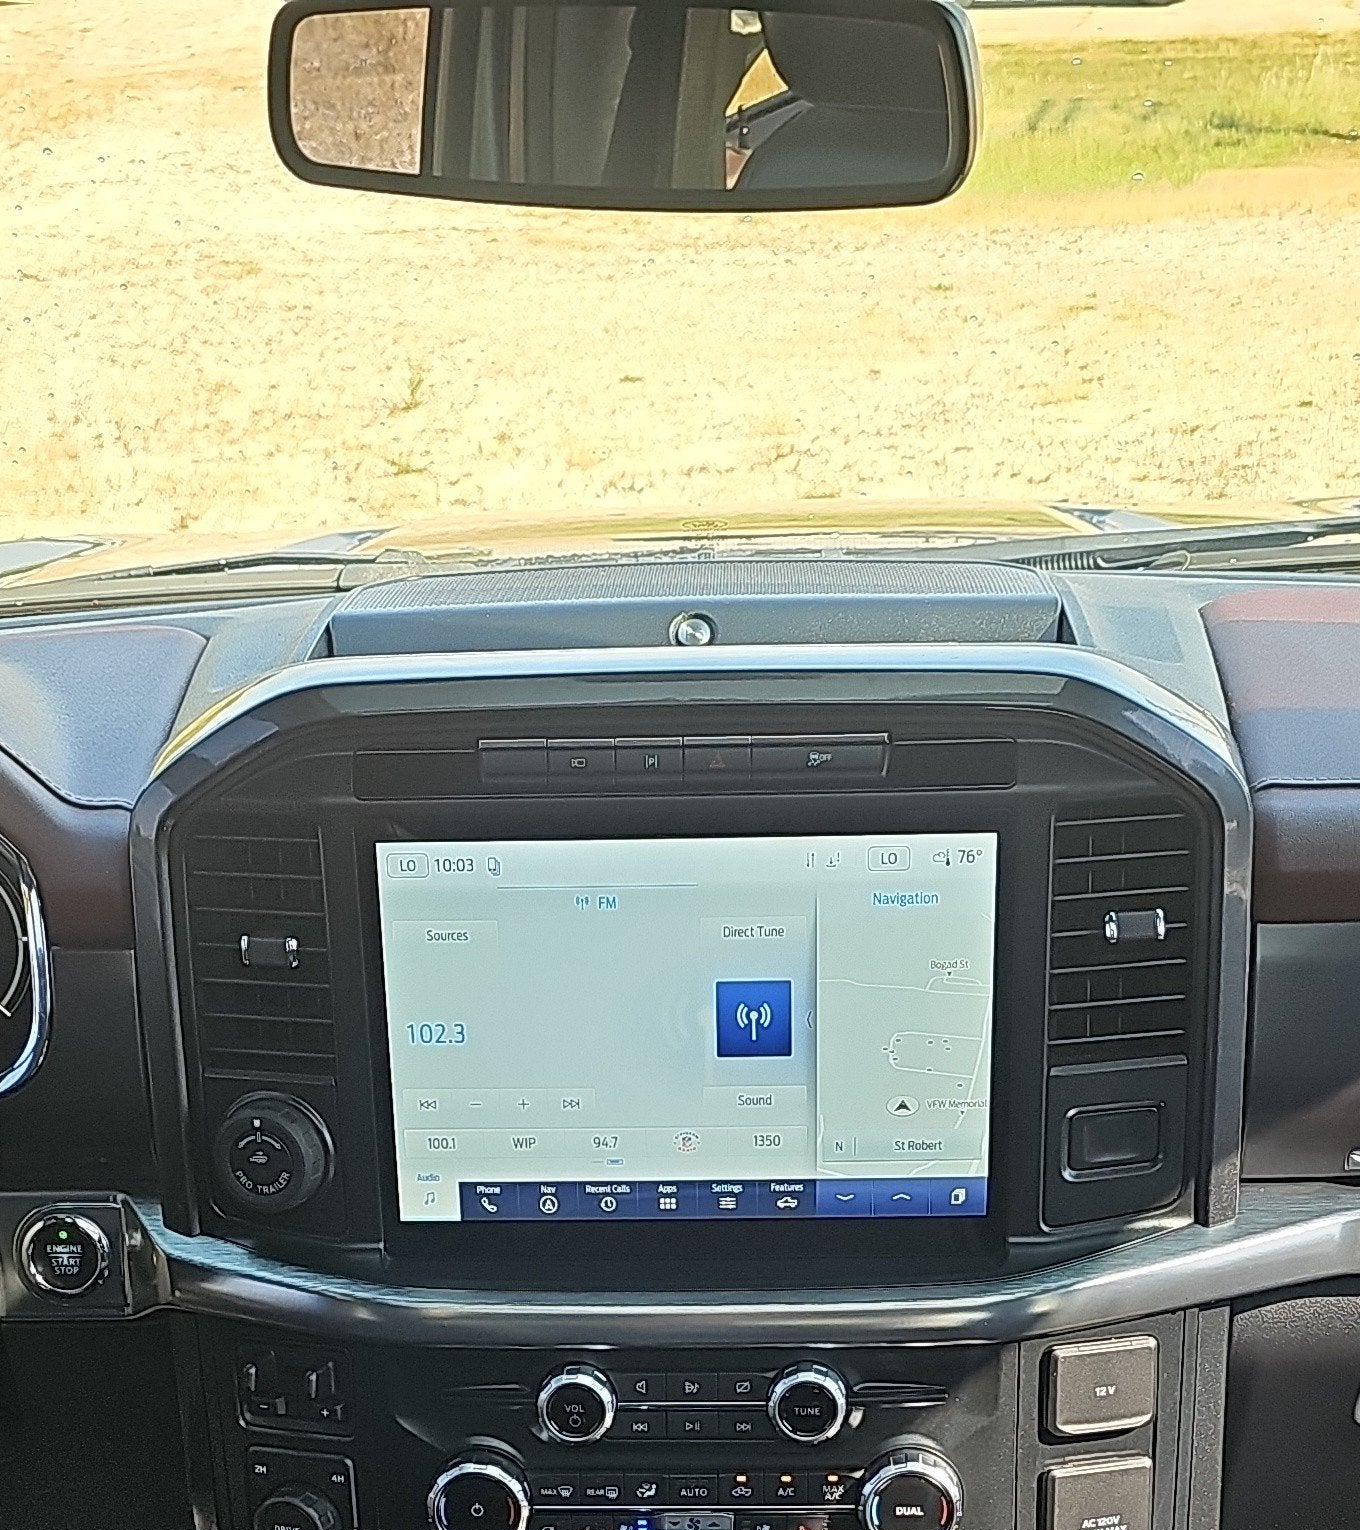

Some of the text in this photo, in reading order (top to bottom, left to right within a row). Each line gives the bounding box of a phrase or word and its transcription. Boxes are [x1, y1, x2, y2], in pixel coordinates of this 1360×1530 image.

[880, 852, 898, 866] LO
[399, 859, 416, 872] LO
[434, 858, 474, 873] 10:03
[598, 897, 617, 909] FM
[872, 892, 939, 905] Navigation
[426, 930, 469, 942] Sources
[722, 925, 785, 938] Direct Tune
[959, 960, 969, 969] St
[406, 1023, 466, 1044] 102.3
[737, 1095, 772, 1106] Sound
[926, 1099, 987, 1109] VFW Memorial
[427, 1137, 456, 1150] 100.1
[512, 1137, 536, 1149] WIP
[593, 1136, 618, 1149] 94.7
[753, 1135, 781, 1147] 1350
[835, 1141, 843, 1151] N
[893, 1140, 943, 1151] St Robert
[235, 1170, 291, 1194] PRO TRAILER
[416, 1173, 440, 1182] Audio
[476, 1184, 501, 1194] Phone
[541, 1184, 556, 1194] Nav
[585, 1184, 631, 1193] Recent Calls
[657, 1184, 677, 1194] Apps
[711, 1183, 743, 1195] Settings
[770, 1182, 804, 1193] Features
[46, 1244, 83, 1253] ENGINE
[51, 1258, 81, 1266] START
[54, 1266, 80, 1275] STOP
[564, 1404, 585, 1413] VOL
[793, 1406, 821, 1416] TUNE
[254, 1464, 267, 1474] 2H
[331, 1474, 345, 1483] 4H
[586, 1488, 605, 1496] REAR
[680, 1488, 708, 1497] AUTO
[777, 1487, 795, 1497] A/C
[822, 1485, 845, 1494] MAX
[895, 1506, 924, 1516] DUAL
[1081, 1514, 1121, 1529] AC 120V
